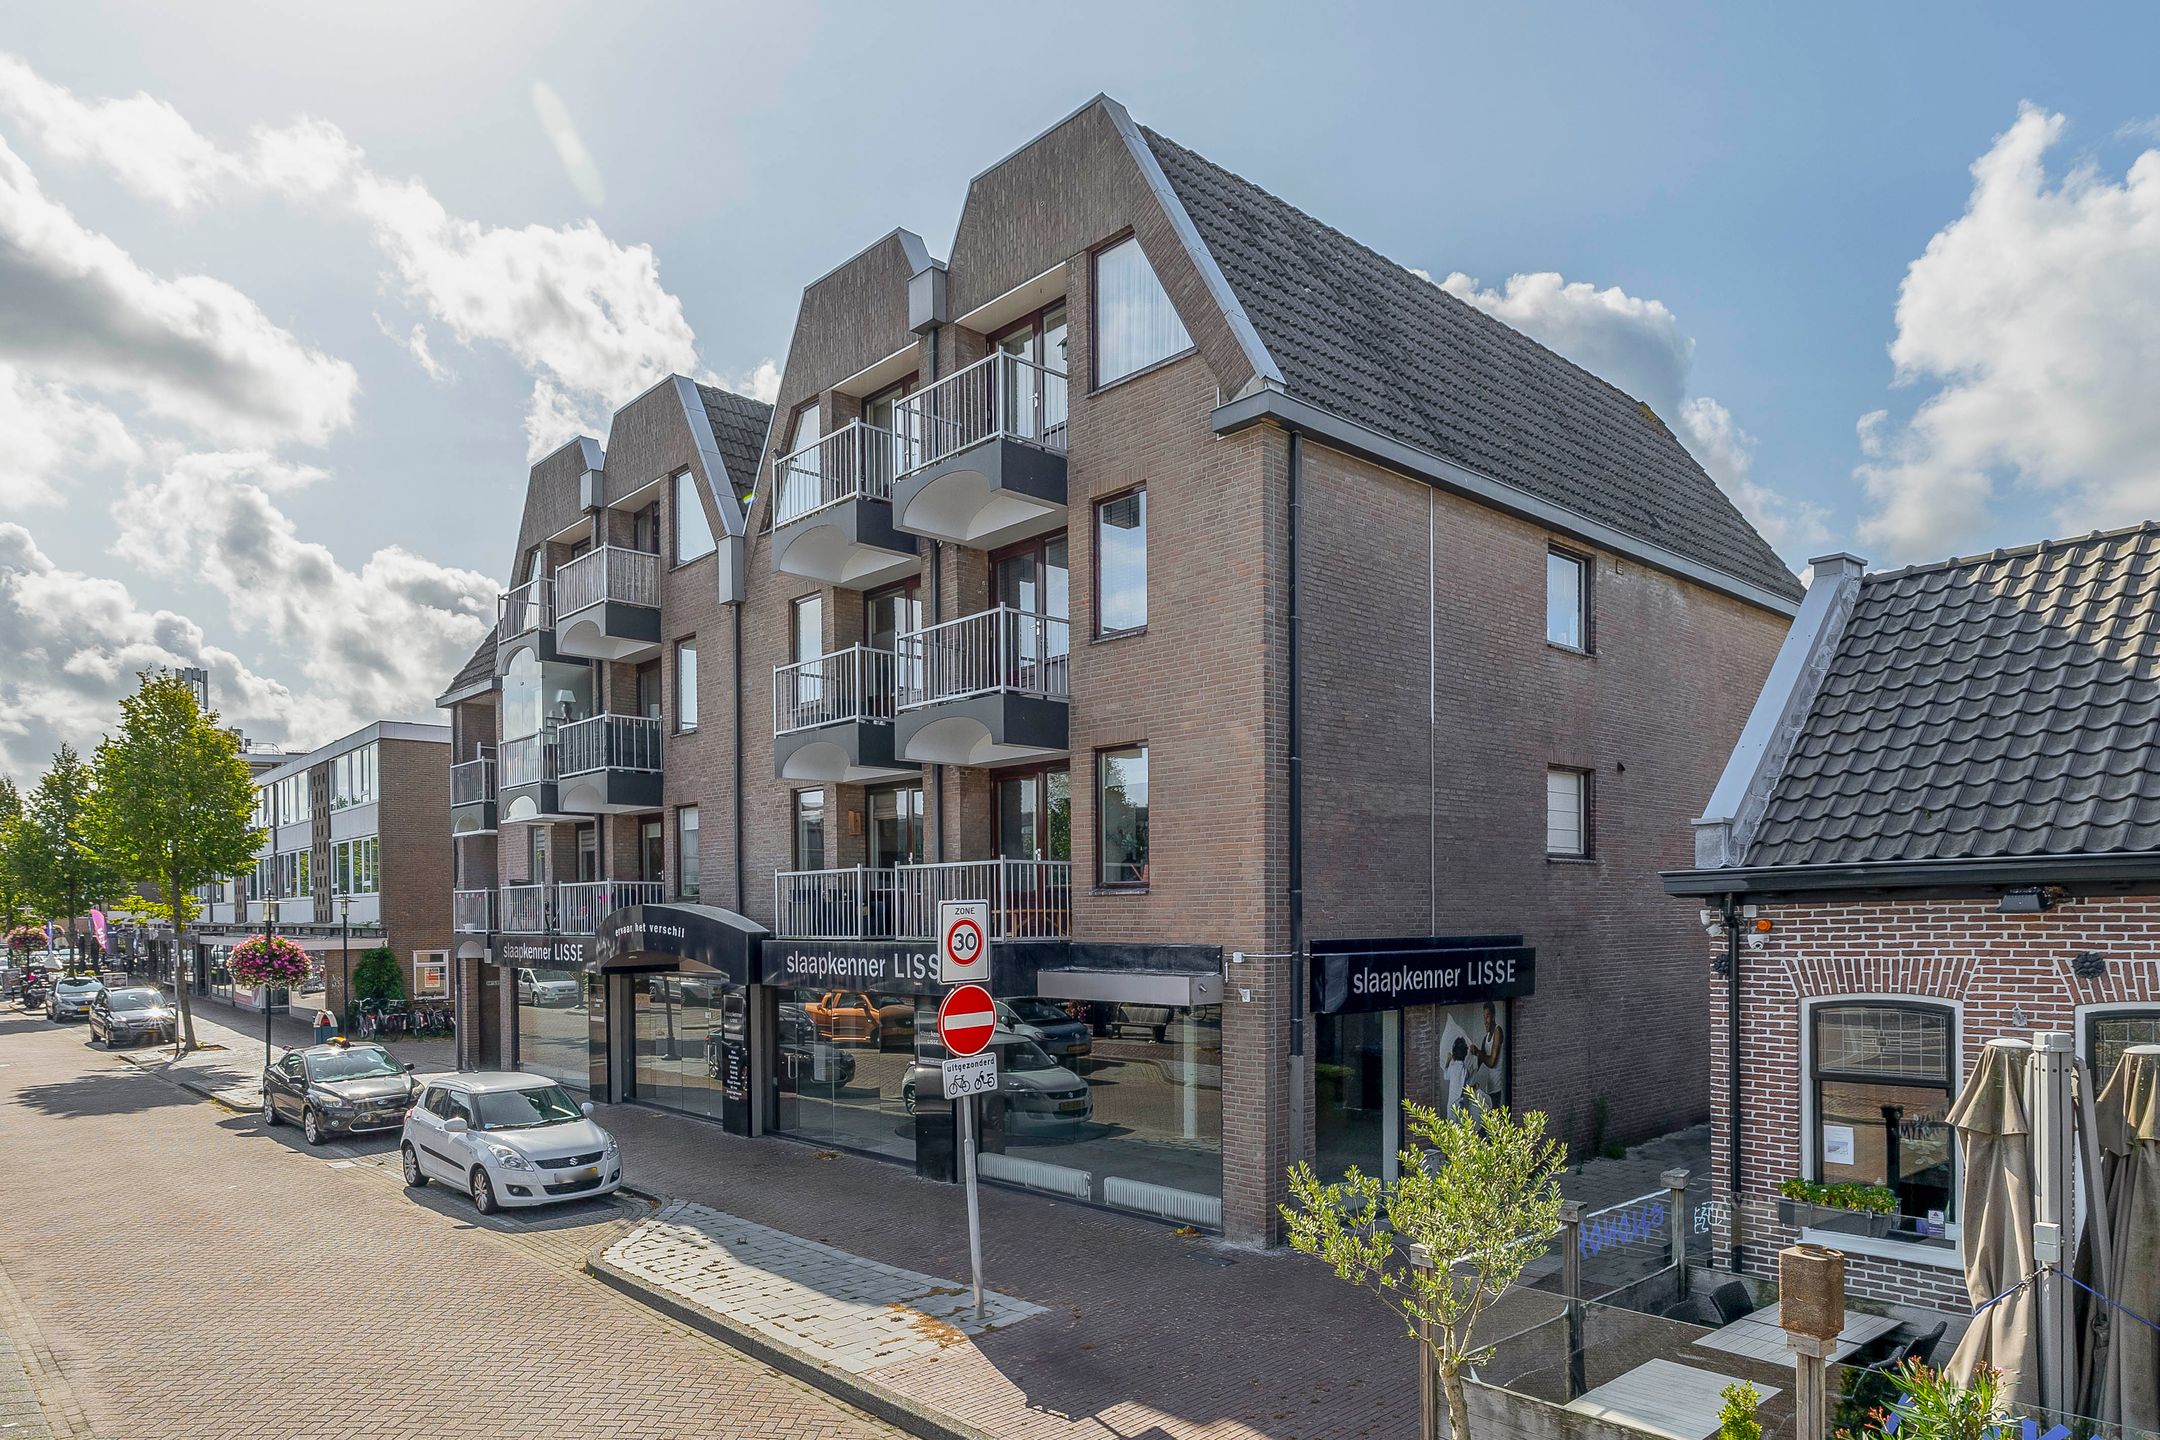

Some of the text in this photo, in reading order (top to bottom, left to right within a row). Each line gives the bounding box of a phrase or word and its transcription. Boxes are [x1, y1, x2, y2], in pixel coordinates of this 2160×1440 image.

[955, 907, 975, 915] ZONE
[615, 922, 685, 938] ervaar het verschil
[953, 932, 977, 951] 30
[503, 942, 583, 961] slaapkenner LISSE
[787, 951, 938, 979] slaapkenner LISS
[1353, 959, 1516, 997] slaapkenner LISSE
[946, 1057, 994, 1072] uitgezonderd
